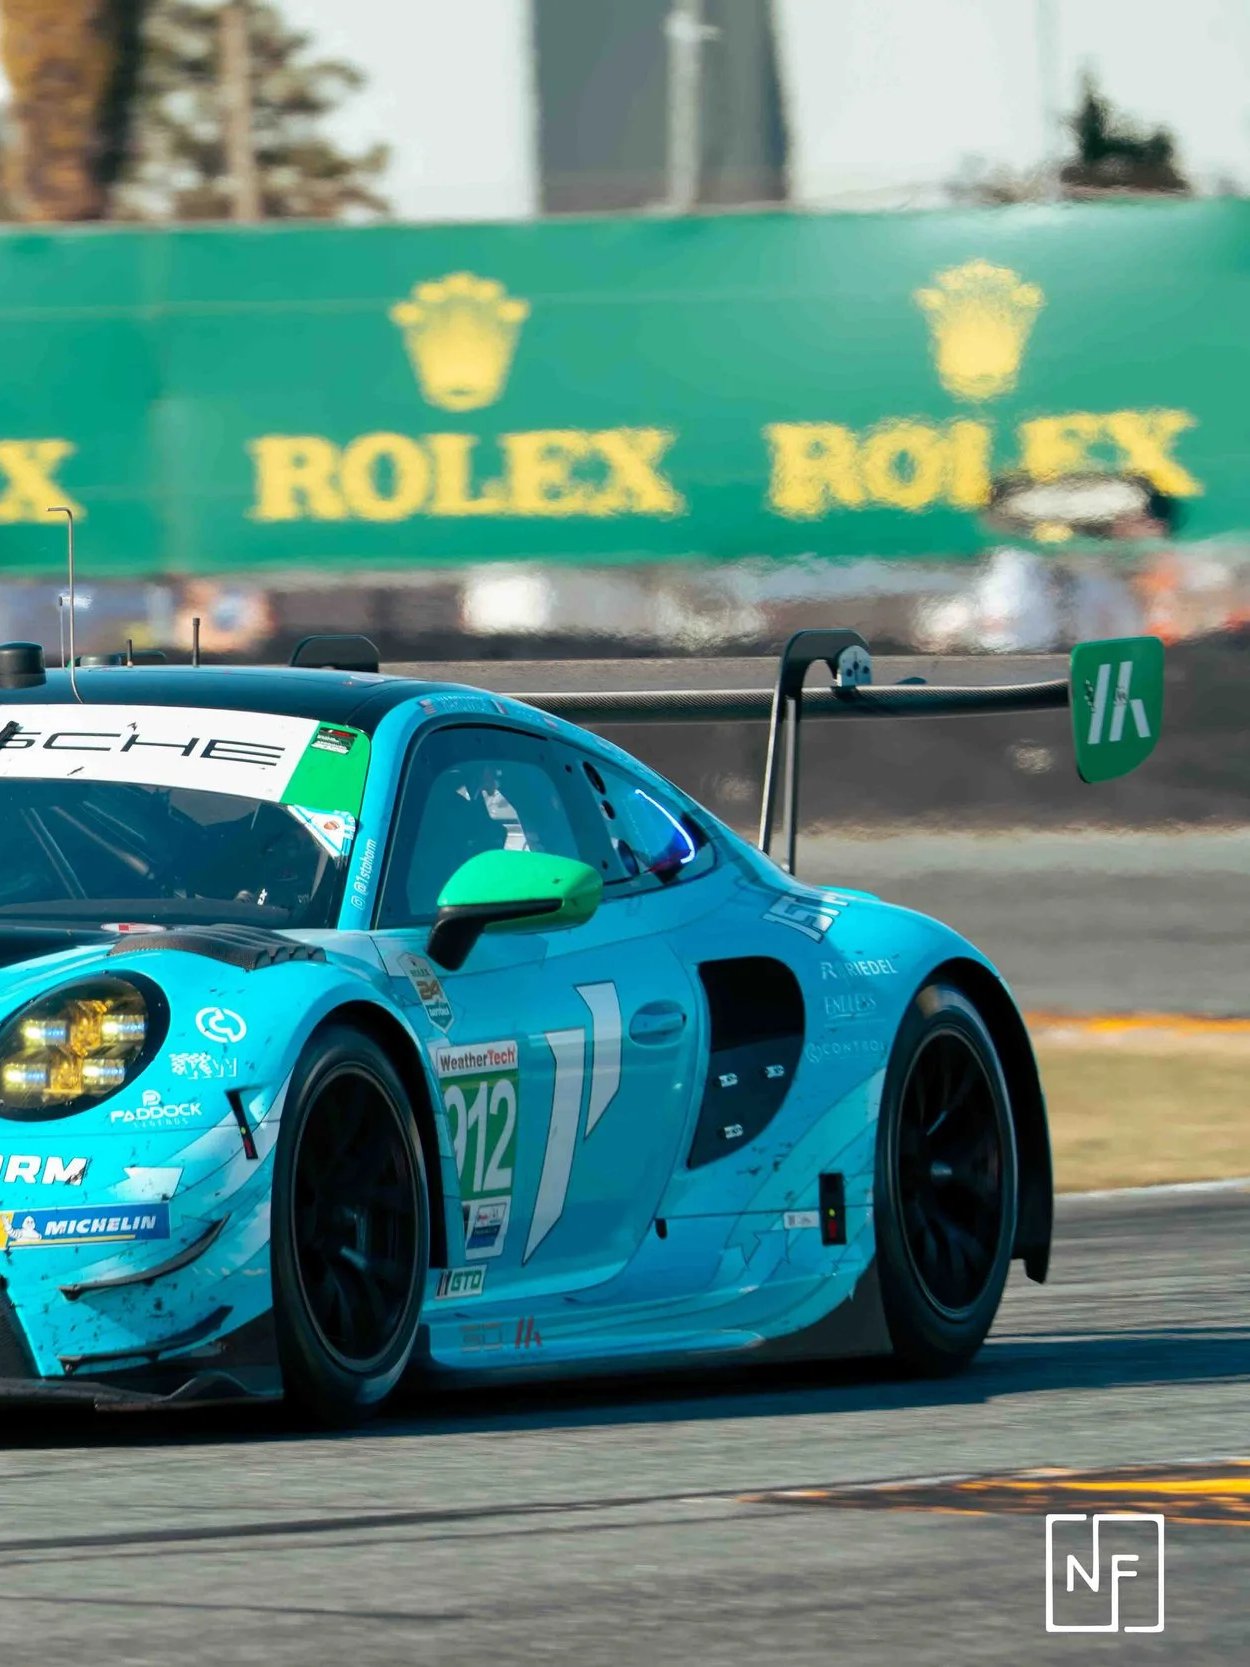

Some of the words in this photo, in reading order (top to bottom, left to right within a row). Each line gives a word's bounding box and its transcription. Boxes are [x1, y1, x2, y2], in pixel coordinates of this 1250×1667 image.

[249, 429, 685, 522] ROLEX
[440, 1049, 515, 1072] WeatherTech
[110, 1103, 203, 1123] PADDOCK
[444, 1079, 516, 1192] 912
[44, 1214, 157, 1236] MICHELIN
